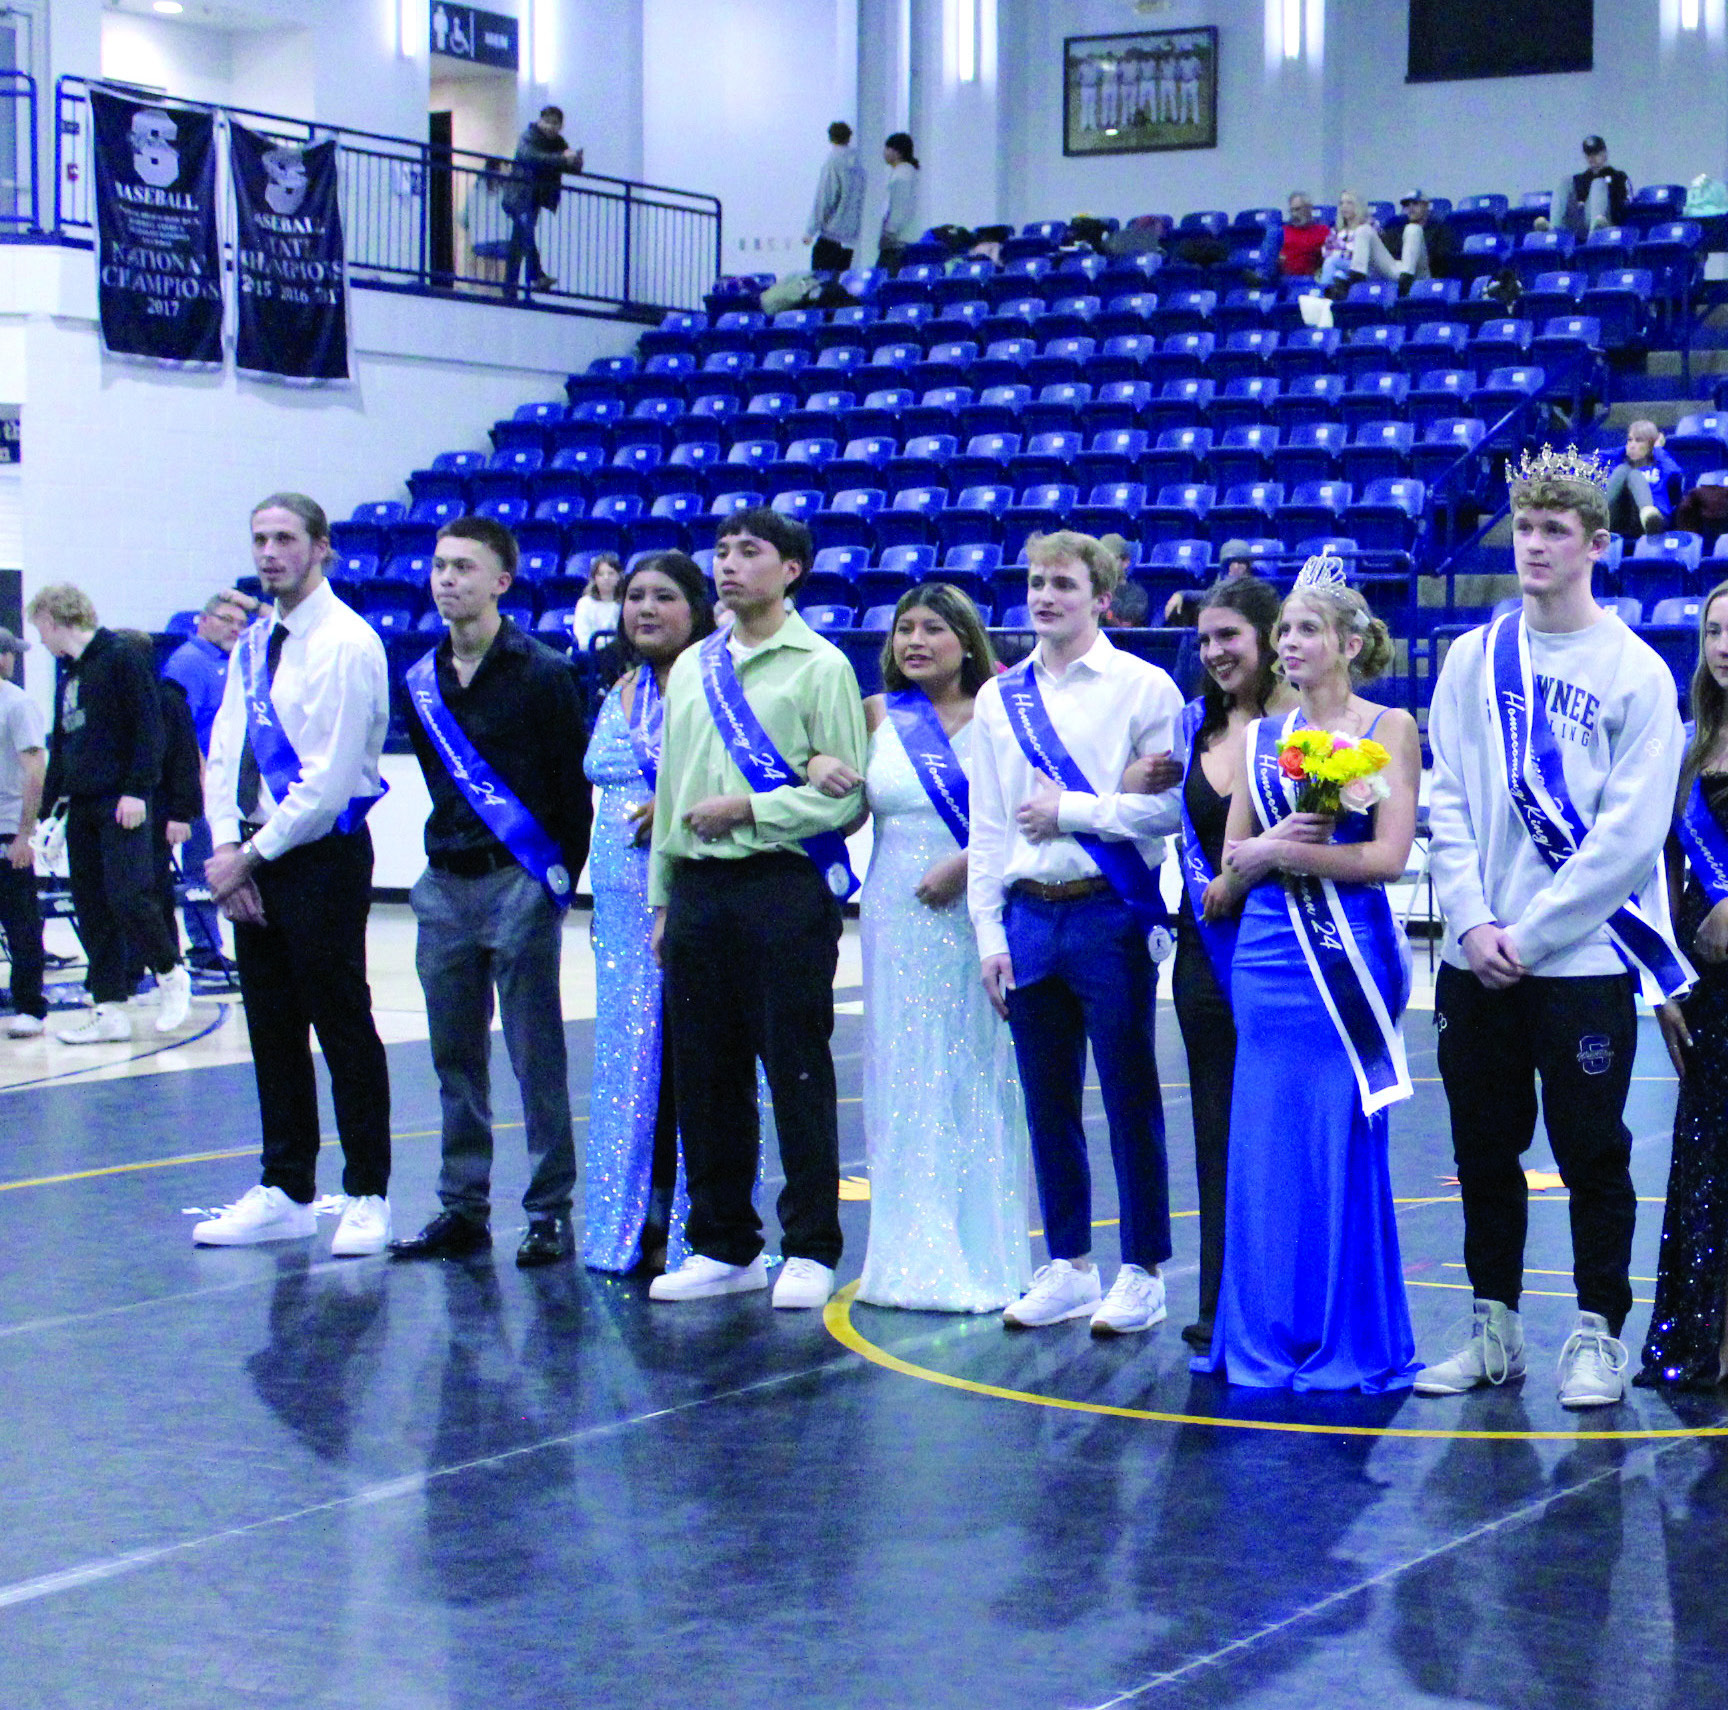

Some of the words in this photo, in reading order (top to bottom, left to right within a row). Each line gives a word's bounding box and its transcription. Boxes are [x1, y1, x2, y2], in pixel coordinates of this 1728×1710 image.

[252, 700, 273, 727] 24
[707, 654, 753, 751] Homecoming
[748, 752, 788, 781] 24
[1501, 690, 1527, 803] Homecoming
[1522, 803, 1553, 848] King
[468, 780, 508, 807] 24
[1186, 856, 1210, 884] 24
[1310, 920, 1344, 951] 24
